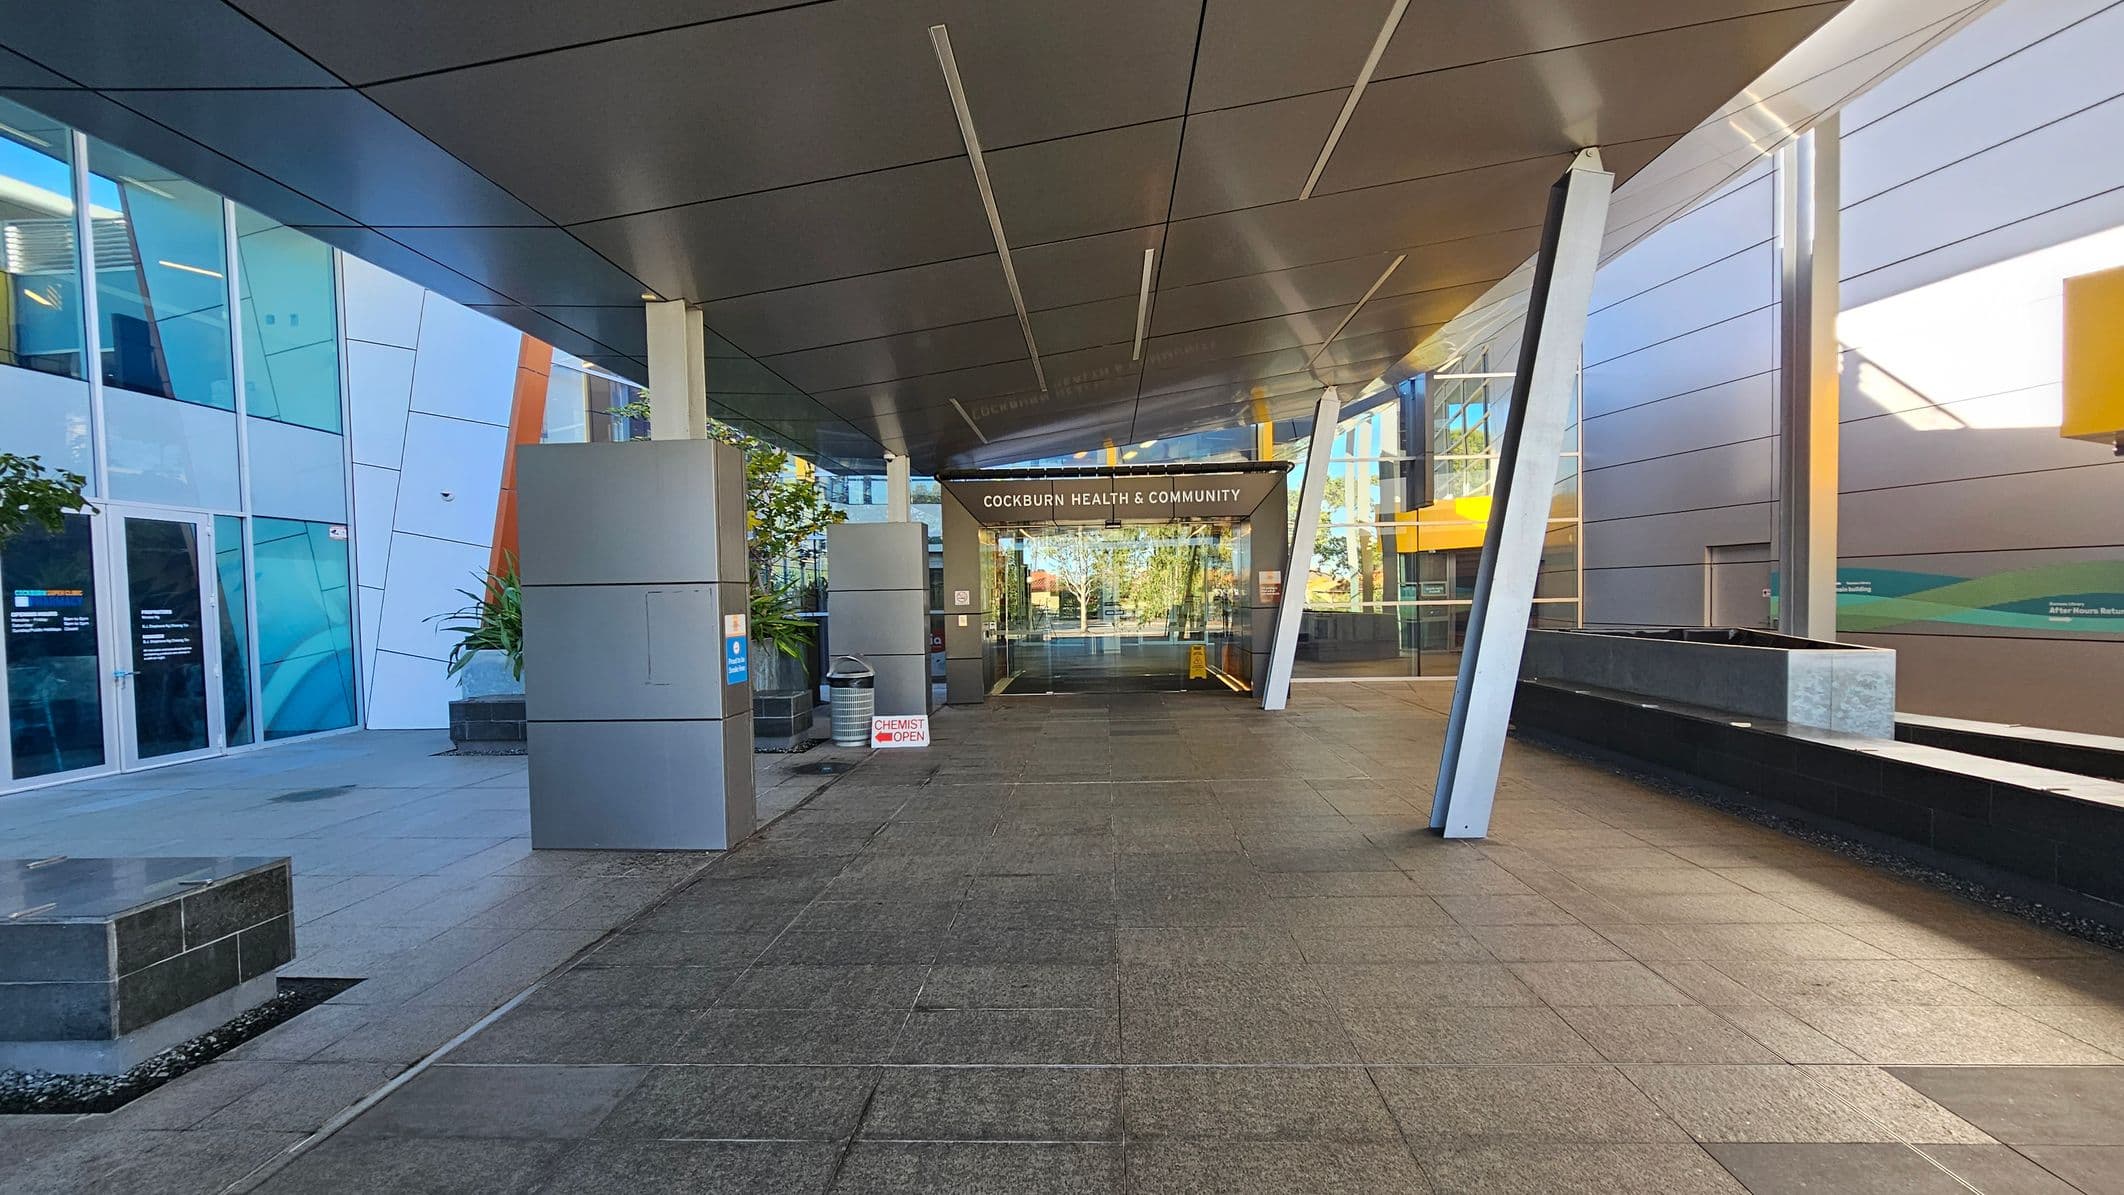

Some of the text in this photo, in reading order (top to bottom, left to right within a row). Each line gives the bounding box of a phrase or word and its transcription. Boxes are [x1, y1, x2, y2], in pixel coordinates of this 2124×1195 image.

[983, 489, 1241, 508] COCKBURN HEALTH & COMMUNITY
[2073, 607, 2099, 615] Hours
[874, 719, 925, 730] CHEMIST
[893, 731, 925, 742] OPEN
